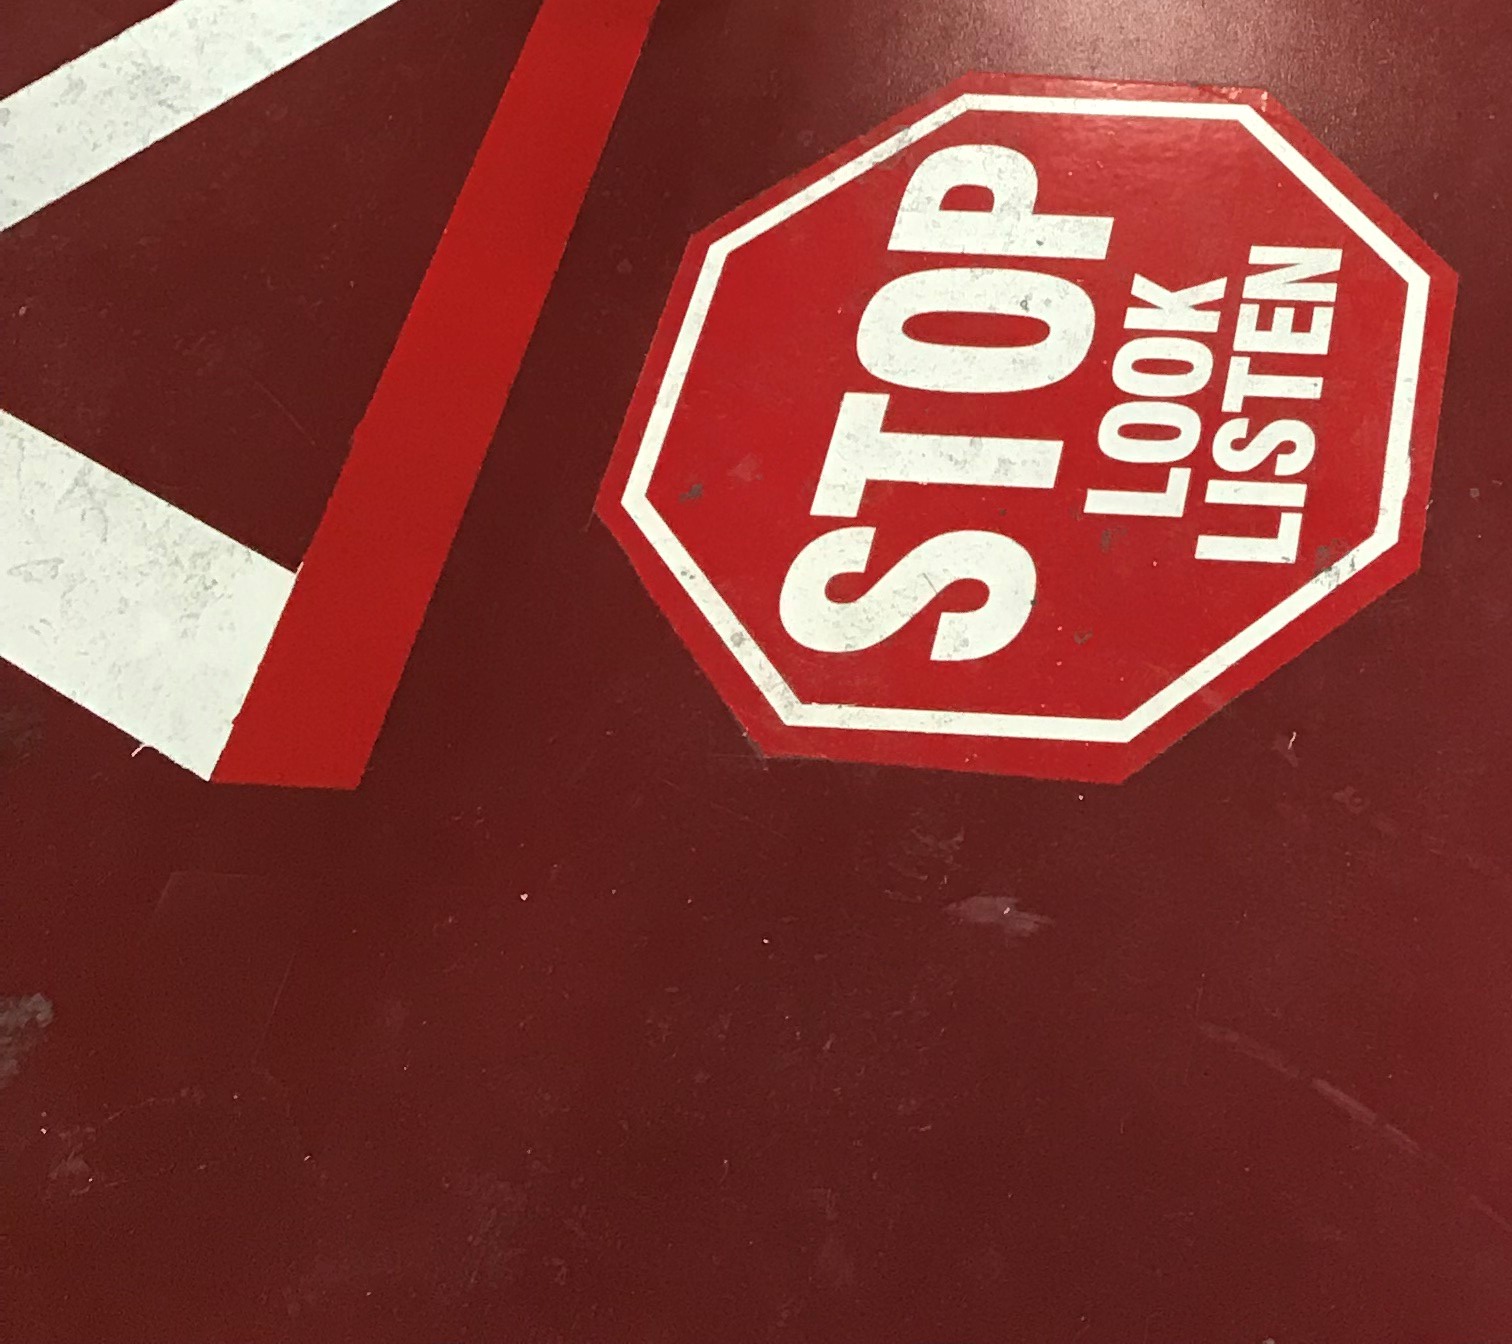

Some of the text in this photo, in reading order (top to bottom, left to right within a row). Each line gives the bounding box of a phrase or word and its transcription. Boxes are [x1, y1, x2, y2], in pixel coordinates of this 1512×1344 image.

[779, 143, 1114, 662] STOP
[1083, 273, 1228, 518] LOOK
[1195, 245, 1343, 564] LISTEN
